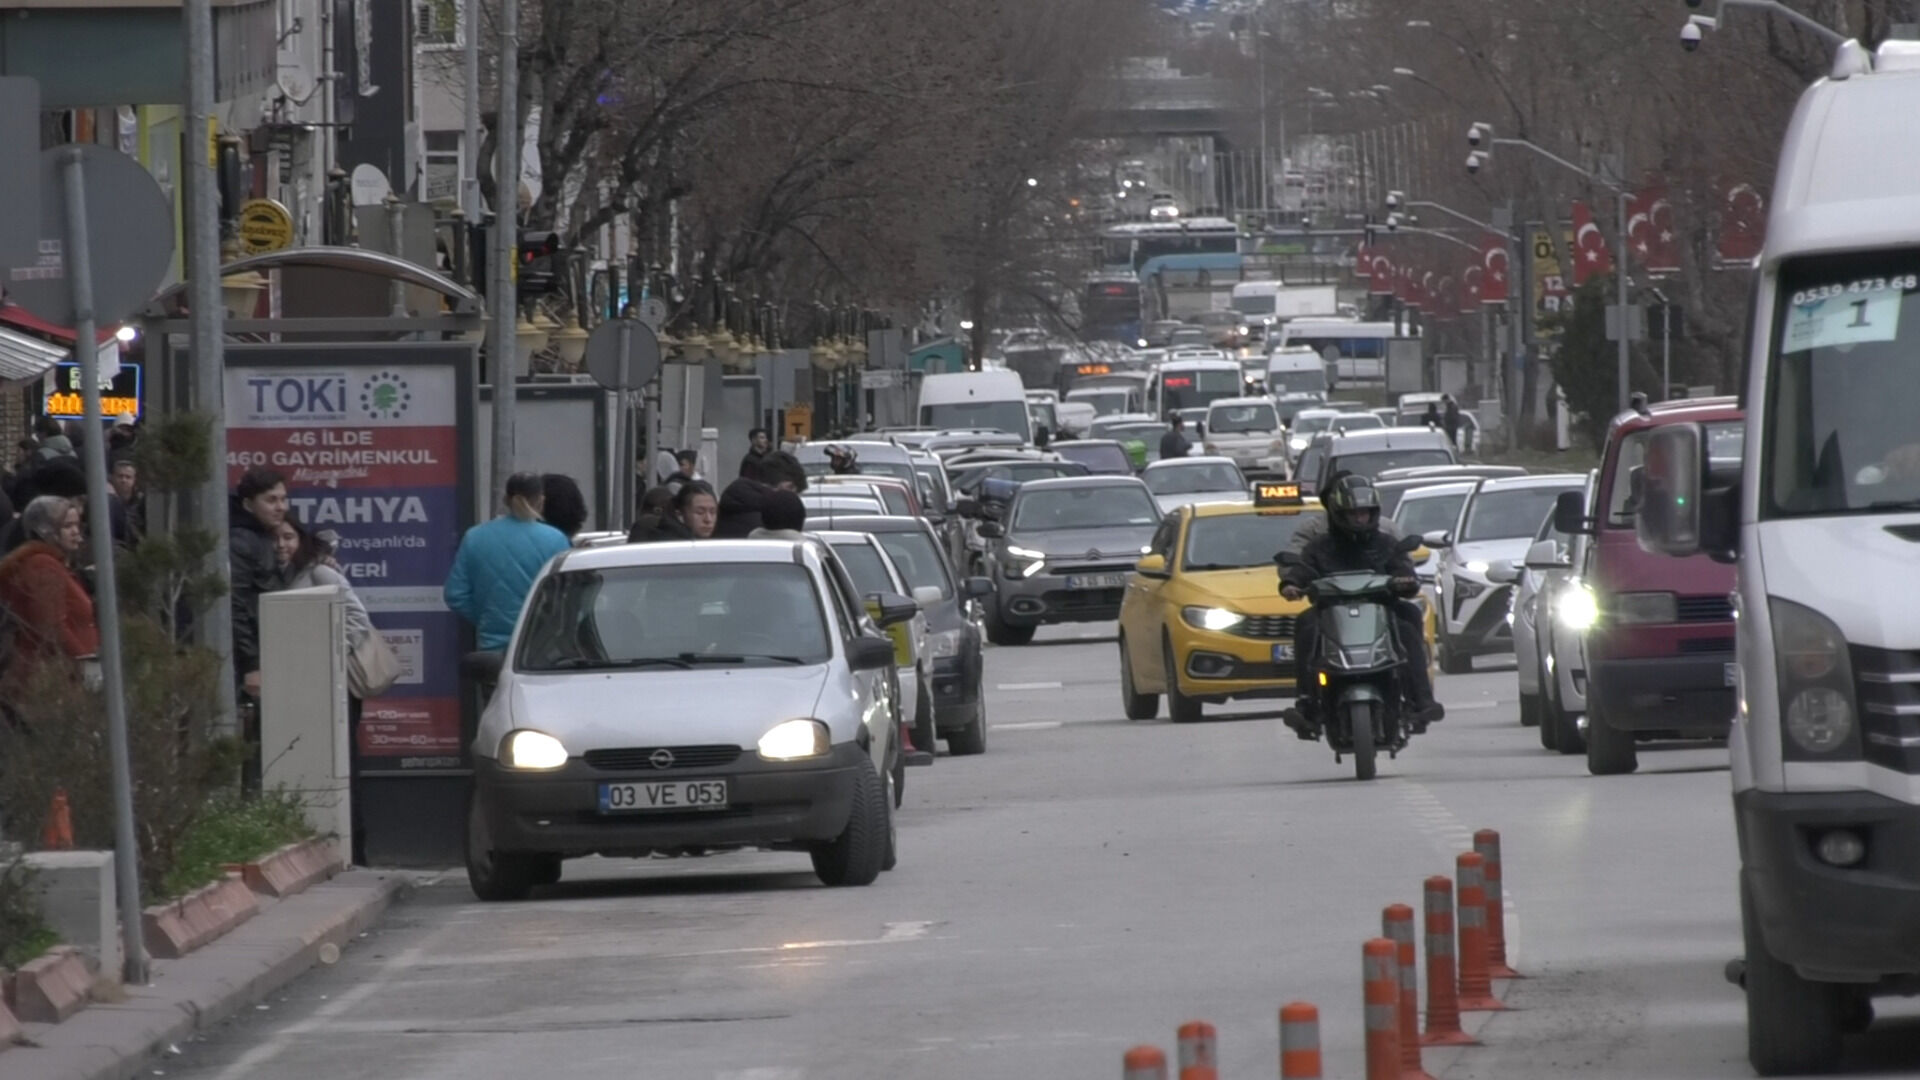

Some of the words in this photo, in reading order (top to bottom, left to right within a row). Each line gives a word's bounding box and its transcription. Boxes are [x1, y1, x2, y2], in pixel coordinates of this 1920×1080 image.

[1793, 284, 1843, 306] 0539
[1848, 278, 1886, 294] 473
[1891, 274, 1918, 289] 68
[1846, 298, 1872, 328] 1
[287, 431, 316, 446] 46
[322, 428, 373, 446] İLDE
[271, 447, 438, 466] GAYRİMENKUL
[291, 496, 428, 524] TAHYA
[610, 786, 636, 806] 03
[646, 784, 677, 805] VE
[686, 782, 725, 804] 053
